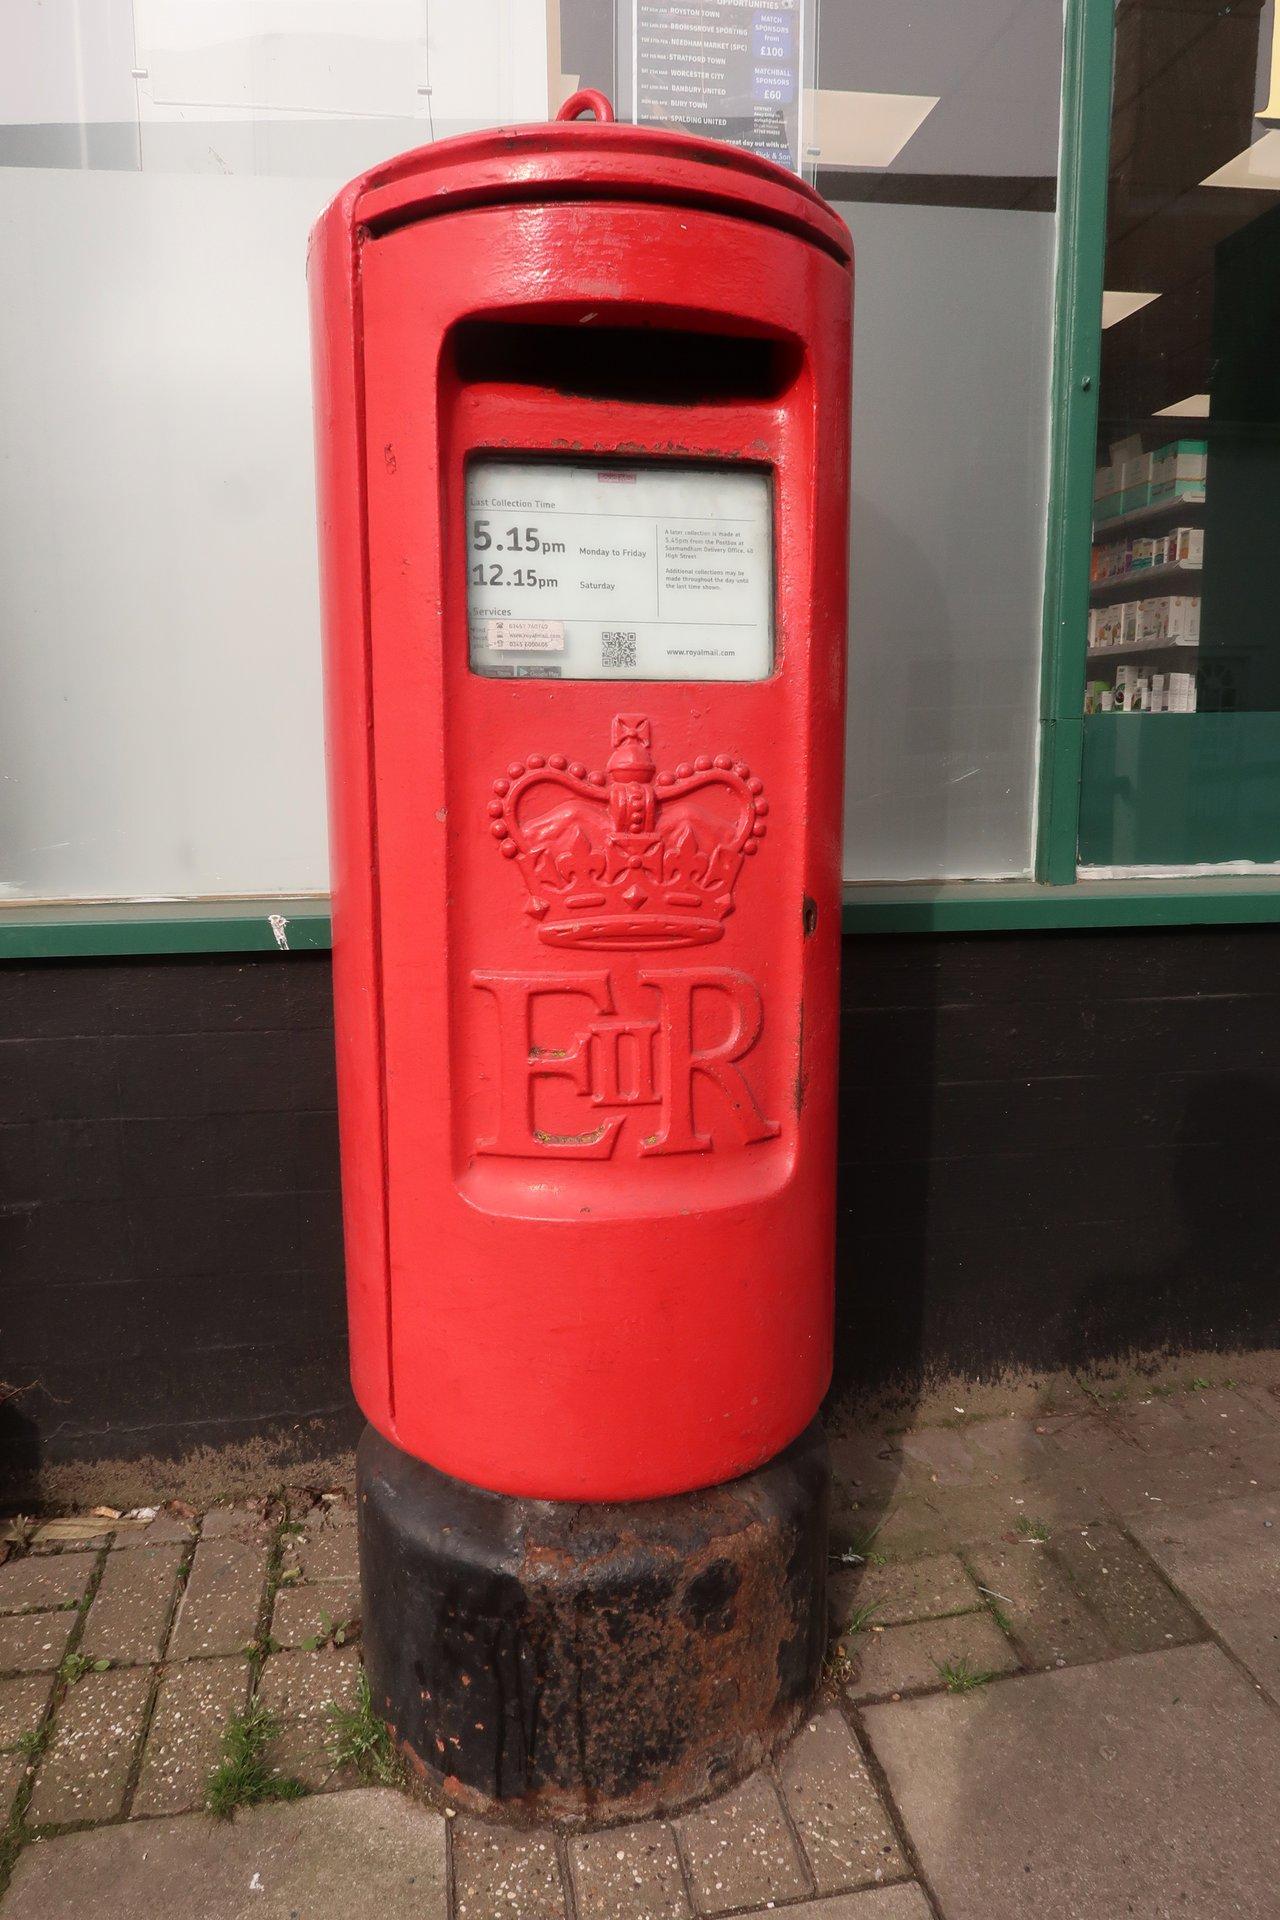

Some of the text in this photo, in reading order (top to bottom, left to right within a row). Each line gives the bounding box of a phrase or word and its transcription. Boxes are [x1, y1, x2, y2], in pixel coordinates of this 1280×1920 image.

[717, 0, 779, 10] OPPORTUNITIES
[670, 7, 700, 17] ROYSTON
[701, 10, 720, 18] TOWN
[760, 14, 783, 24] MATCH
[670, 22, 715, 34] BROMSGROVE
[715, 26, 748, 37] SPORTING
[755, 24, 789, 34] SPONSORS
[764, 34, 780, 42] from
[671, 38, 703, 48] NEEDHAM
[703, 41, 729, 50] MARKET
[760, 46, 784, 57] £100
[669, 53, 706, 64] STRATFORD
[707, 56, 726, 65] TOWN
[670, 69, 710, 79] WORCESTER
[710, 72, 725, 80] CITY
[754, 67, 791, 77] MATCHBALL
[755, 77, 790, 86] SPONSORS
[671, 84, 701, 95] BANBURY
[702, 87, 727, 96] UNITED
[764, 90, 781, 100] £60
[670, 99, 688, 108] BURY
[689, 101, 708, 109] TOWN
[670, 115, 702, 125] SPALDING
[703, 117, 727, 126] UNITED
[766, 140, 780, 148] with
[778, 152, 791, 161] Son
[471, 498, 556, 509] Last Collection Time
[473, 520, 566, 555] 5.15pm
[665, 537, 689, 545] 5.45pm
[579, 547, 647, 558] Monday to Friday
[472, 563, 558, 589] 12.15pm
[682, 576, 713, 584] throughout
[724, 577, 735, 585] day
[579, 581, 616, 591] Saturday
[473, 607, 512, 617] Services
[666, 648, 736, 657] www.royalmail.com
